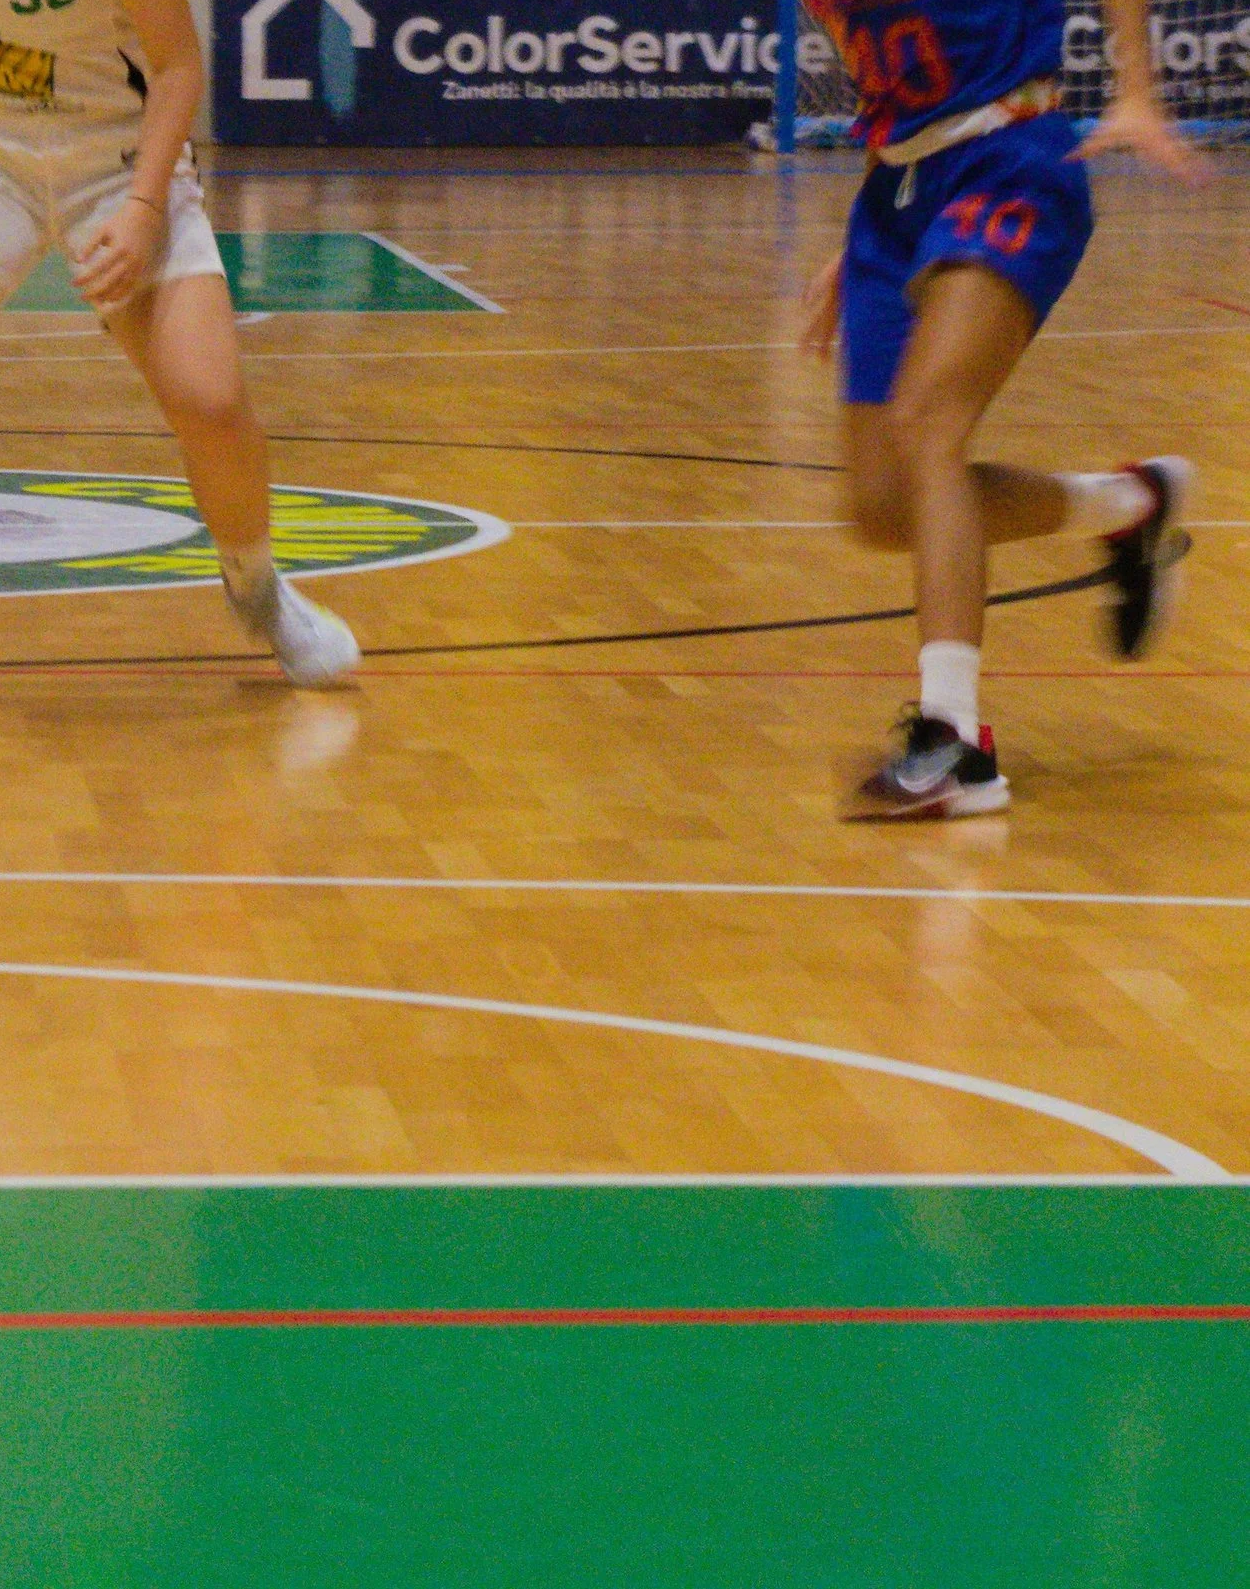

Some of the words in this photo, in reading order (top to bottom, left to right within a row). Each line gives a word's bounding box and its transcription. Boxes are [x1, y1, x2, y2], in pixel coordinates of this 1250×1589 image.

[442, 81, 520, 100] Zanetti:
[550, 80, 619, 104] qualità
[664, 82, 726, 99] nostra
[731, 81, 776, 99] firm
